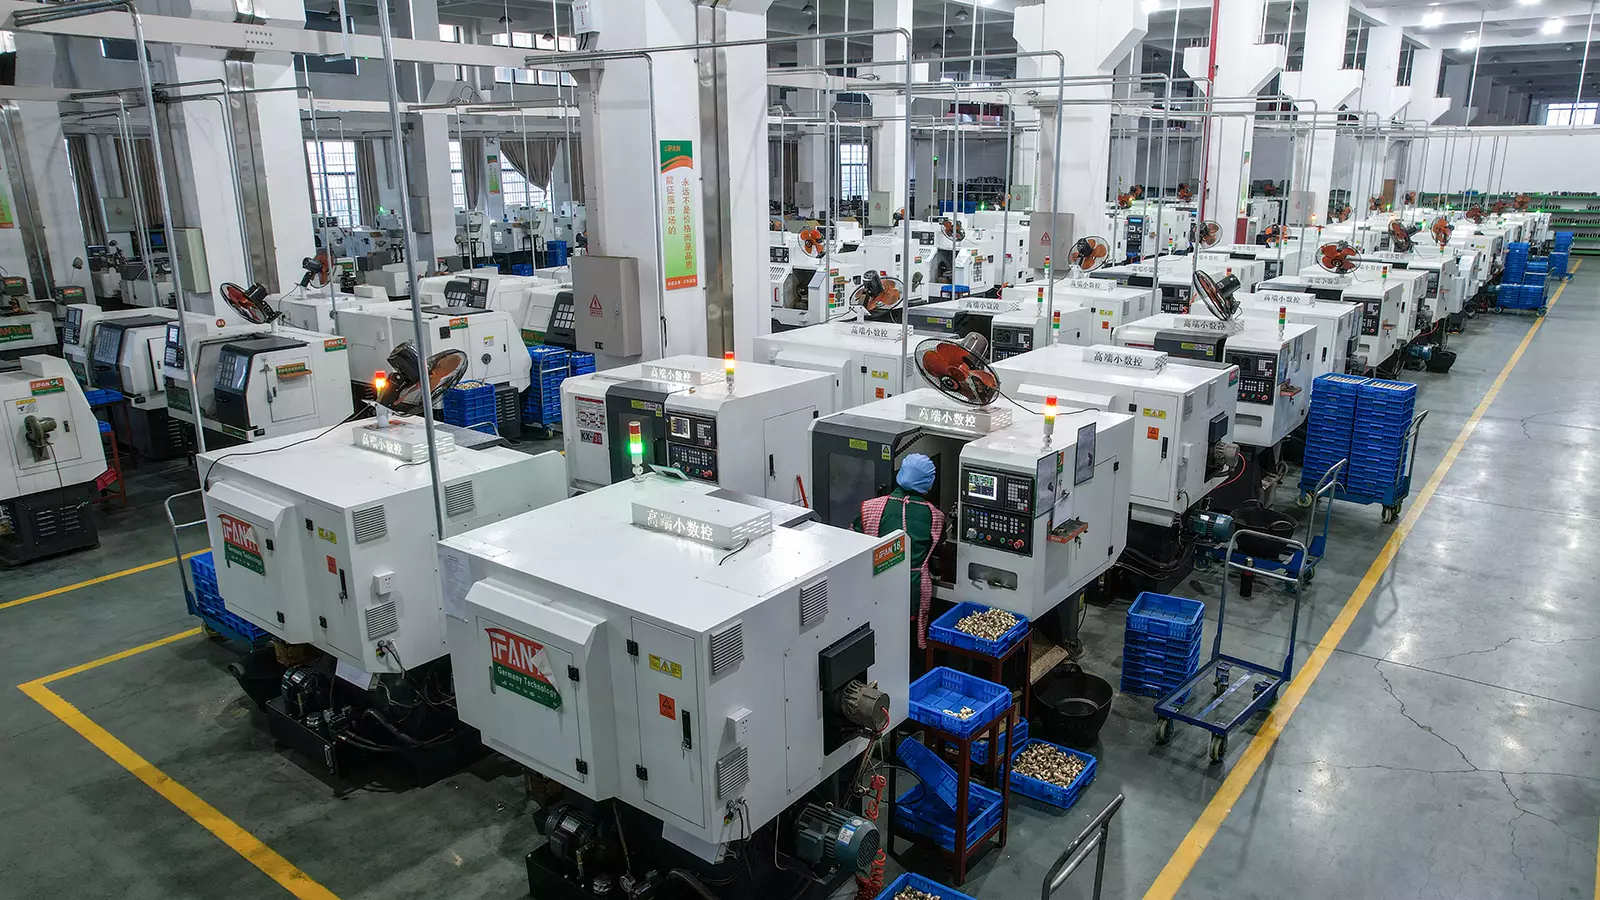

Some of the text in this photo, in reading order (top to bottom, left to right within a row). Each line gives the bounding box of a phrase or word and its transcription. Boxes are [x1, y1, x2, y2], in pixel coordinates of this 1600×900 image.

[665, 175, 677, 235] 能征服市场的
[682, 177, 693, 270] 永远不是价格而是品质
[1094, 351, 1143, 367] 高端小数控
[650, 366, 691, 383] 高端小数控
[919, 407, 976, 428] 高端小数控
[362, 432, 403, 456] 高端小数控
[647, 509, 714, 542] 高端小数控
[893, 540, 902, 552] 18
[497, 666, 558, 700] Germany Technology
